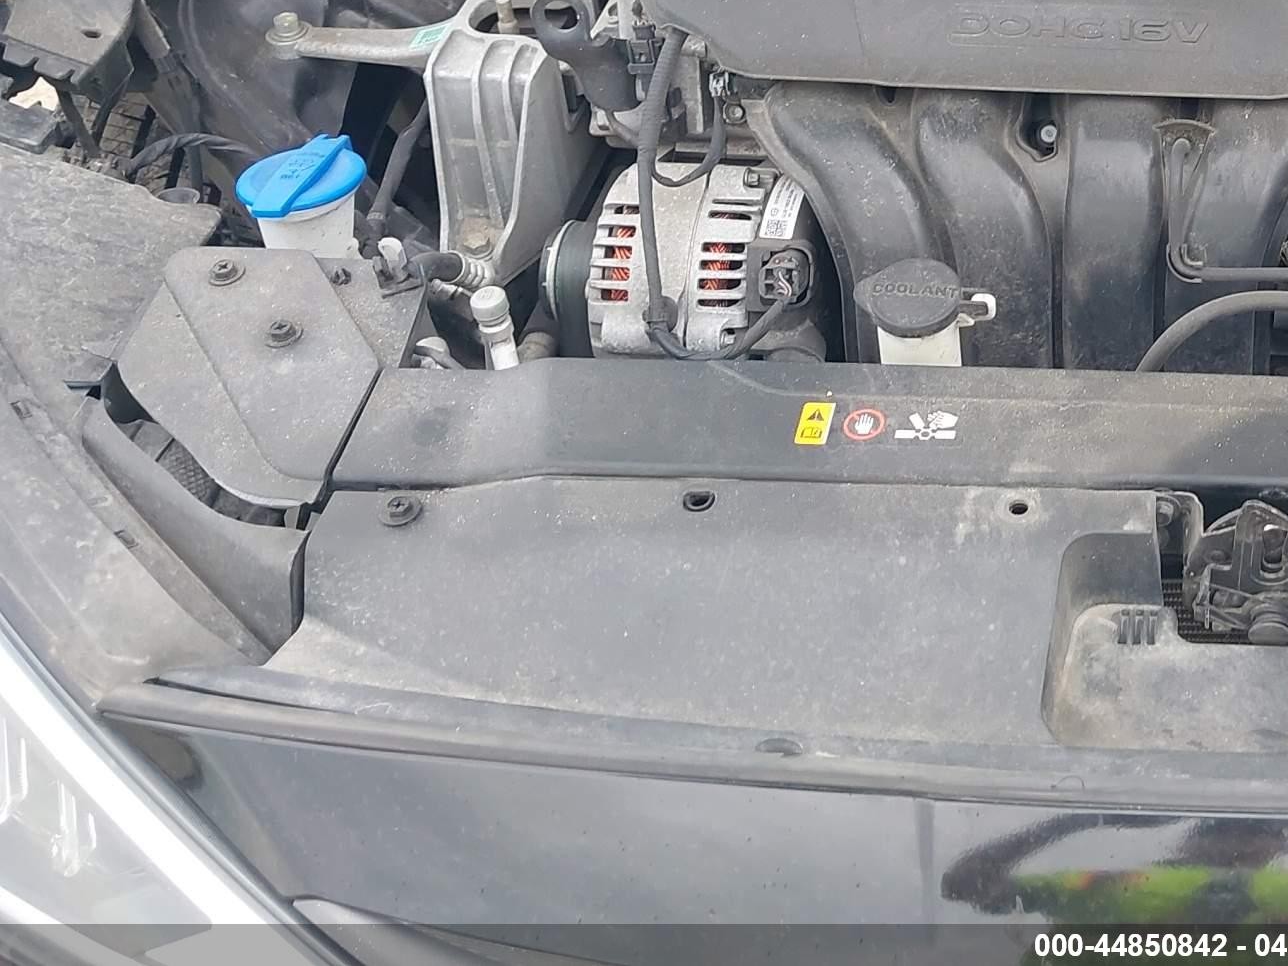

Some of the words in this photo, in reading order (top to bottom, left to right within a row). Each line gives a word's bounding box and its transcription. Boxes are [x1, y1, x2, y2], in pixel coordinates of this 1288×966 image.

[950, 13, 1105, 40] DOHC
[1119, 16, 1209, 44] 16V
[872, 282, 959, 299] COOLANT
